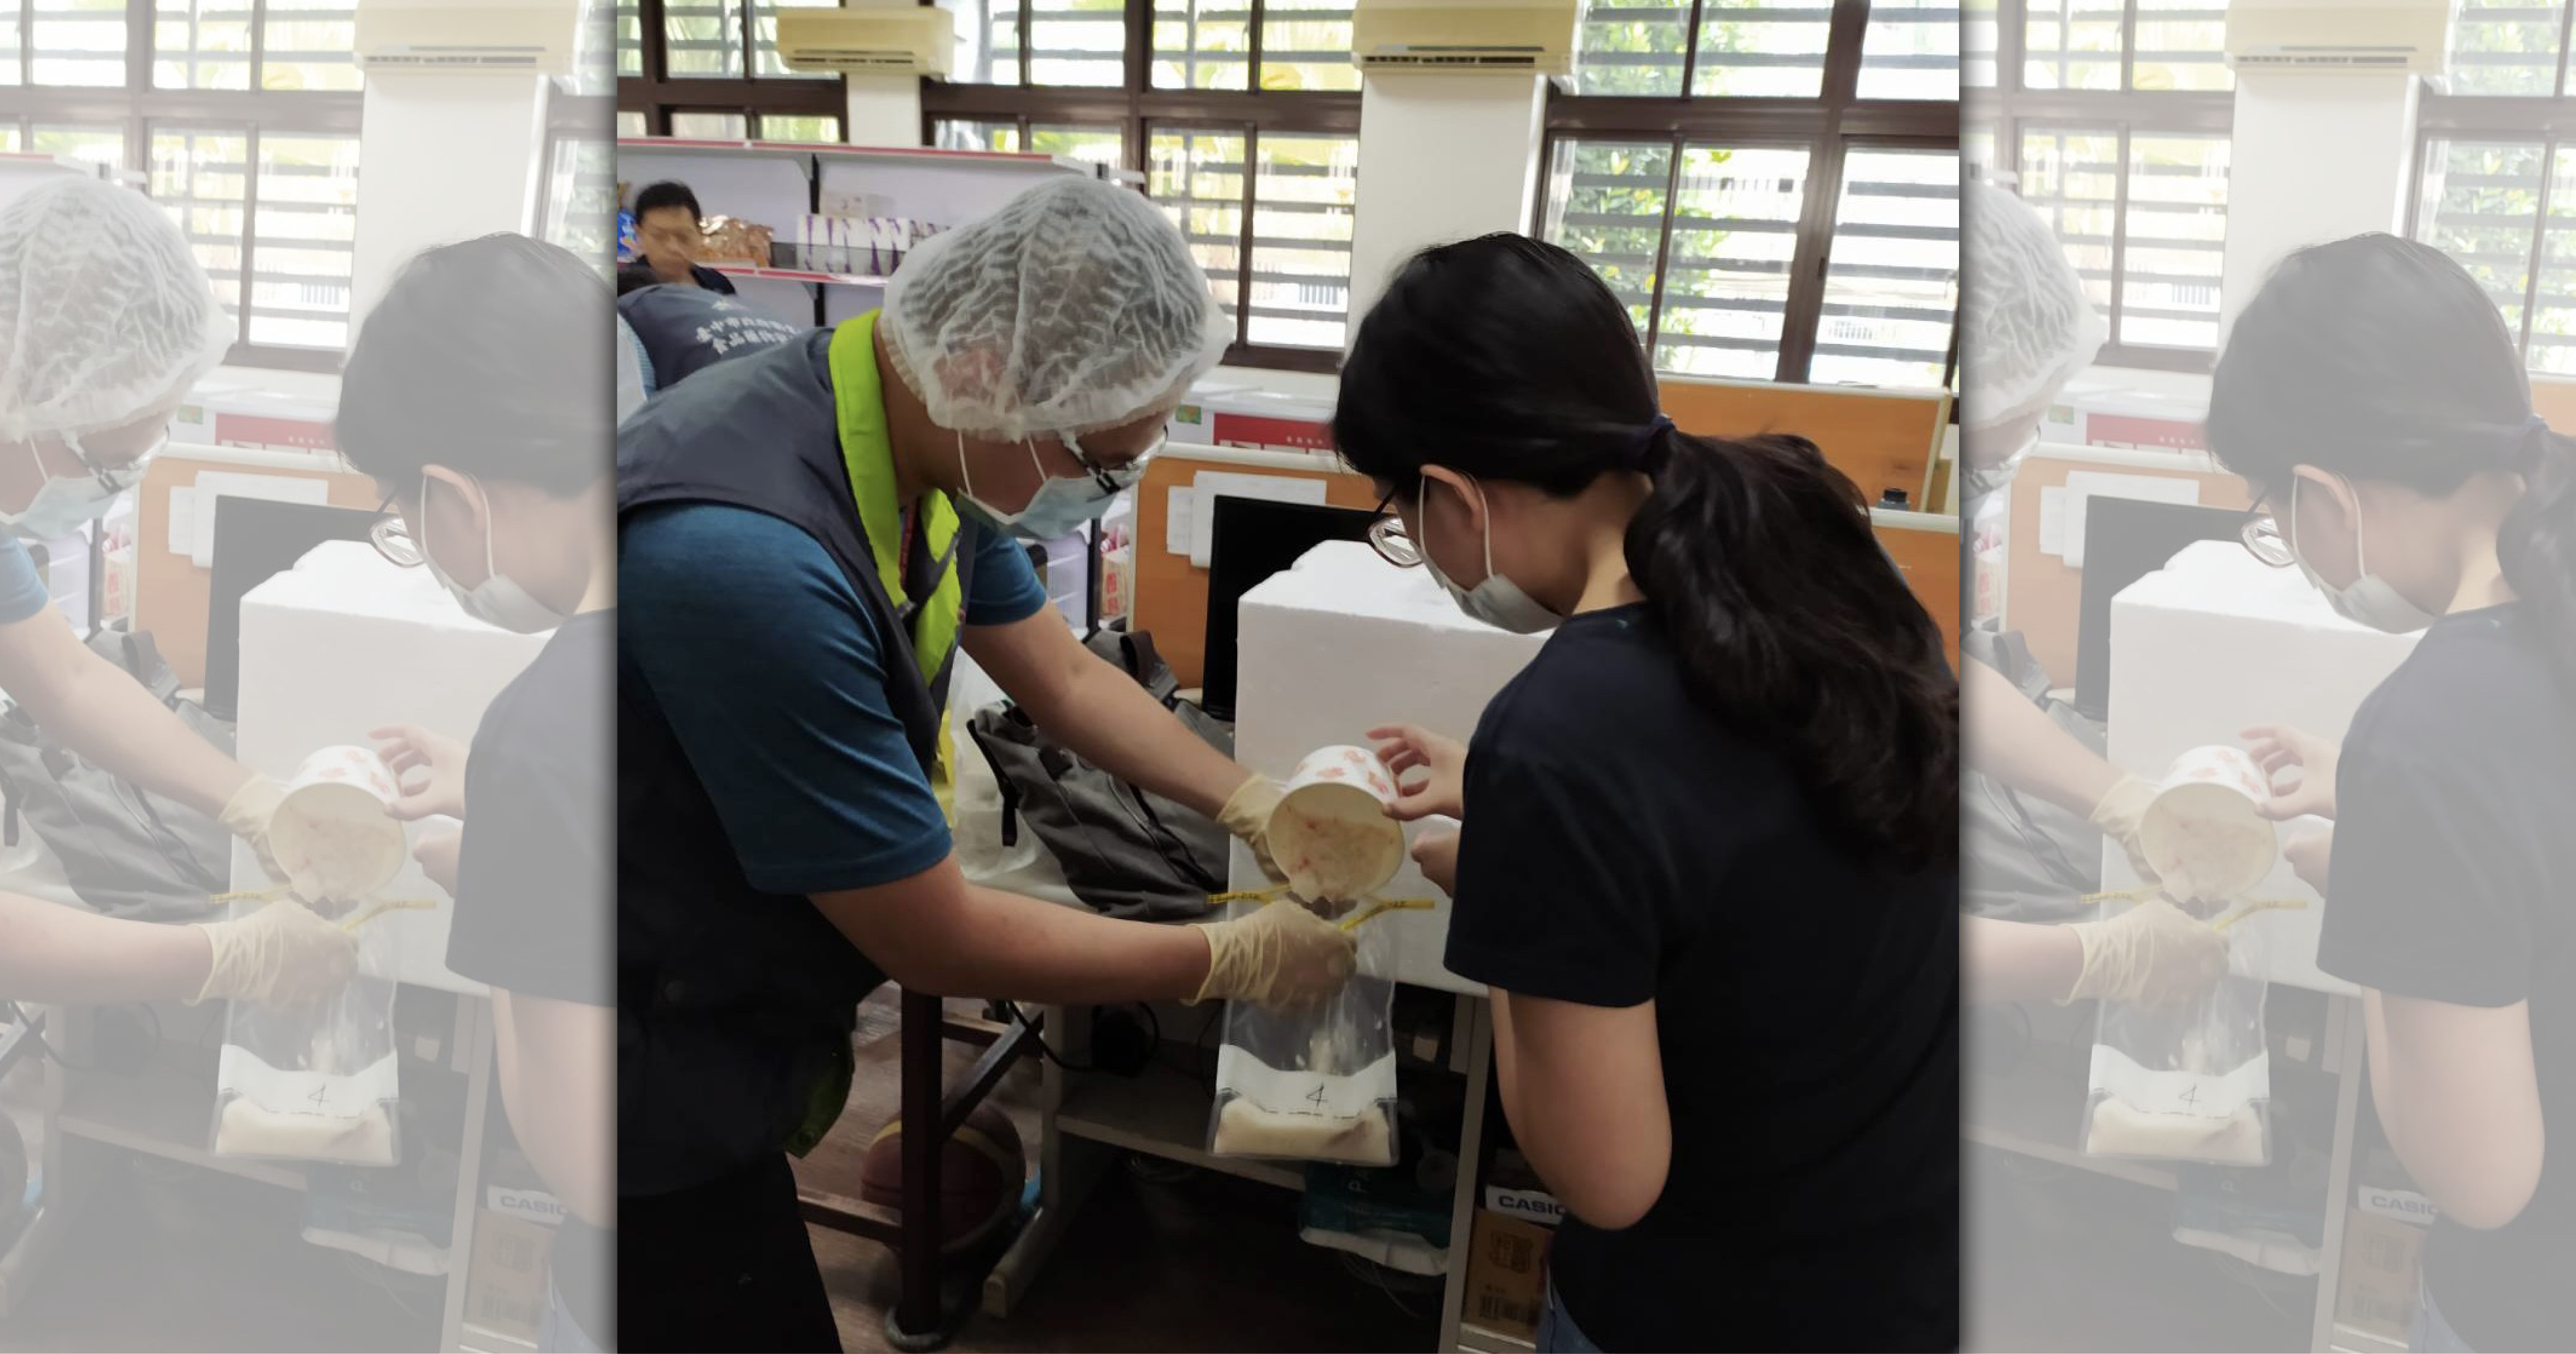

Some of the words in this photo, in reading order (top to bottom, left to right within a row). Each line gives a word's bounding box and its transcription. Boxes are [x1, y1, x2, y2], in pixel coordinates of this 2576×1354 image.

[307, 1083, 329, 1107] 4
[1305, 1083, 1328, 1107] 4
[2178, 1083, 2201, 1107] 4
